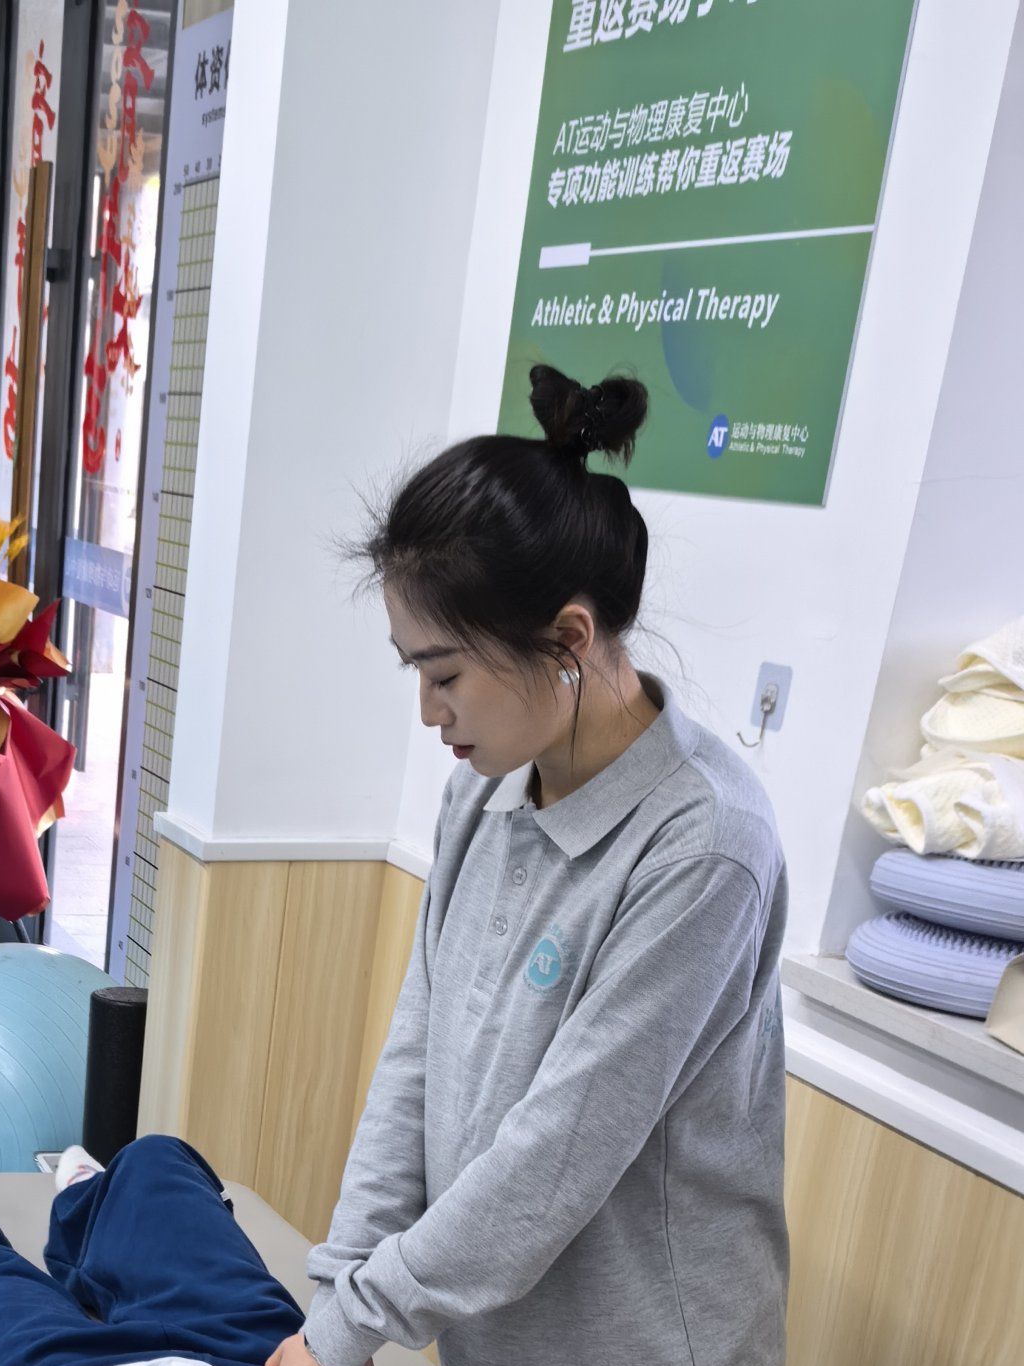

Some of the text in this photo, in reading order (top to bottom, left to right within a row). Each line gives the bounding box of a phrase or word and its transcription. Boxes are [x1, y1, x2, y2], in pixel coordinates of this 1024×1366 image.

[553, 82, 749, 155] AT运动与物理康复中心
[547, 131, 793, 208] 专项功能训练帮你重返赛场
[531, 286, 780, 332] Athletic & Physical Therapy
[707, 426, 729, 448] AT
